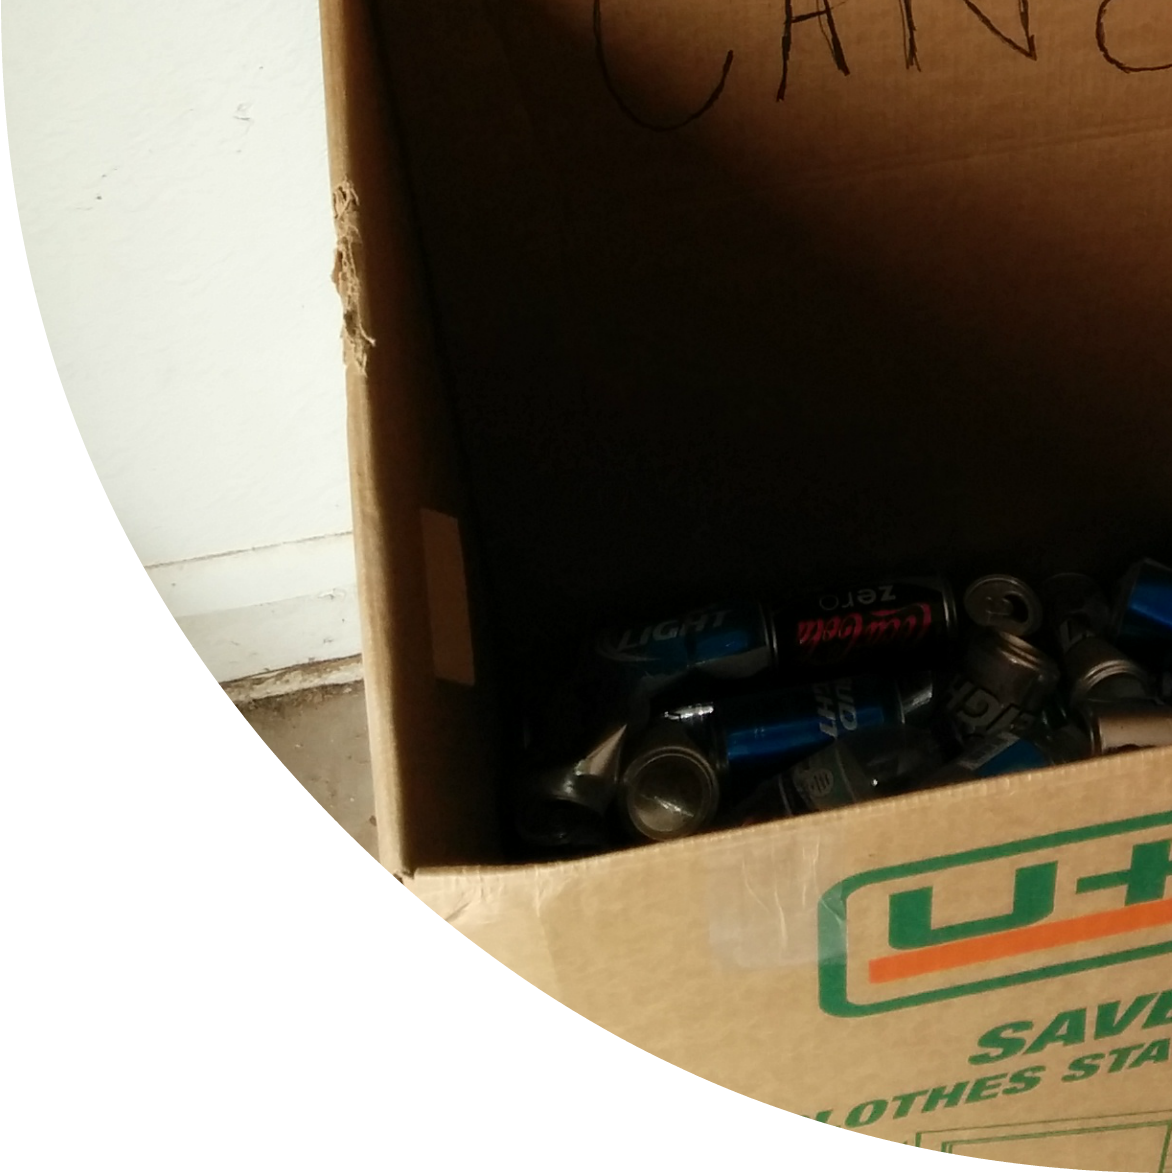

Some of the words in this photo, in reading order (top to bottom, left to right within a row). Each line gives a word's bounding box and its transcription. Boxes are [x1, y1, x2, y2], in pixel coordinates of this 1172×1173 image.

[819, 583, 897, 612] zero
[617, 608, 736, 651] LIGHT
[802, 1064, 1047, 1128] LOTHES
